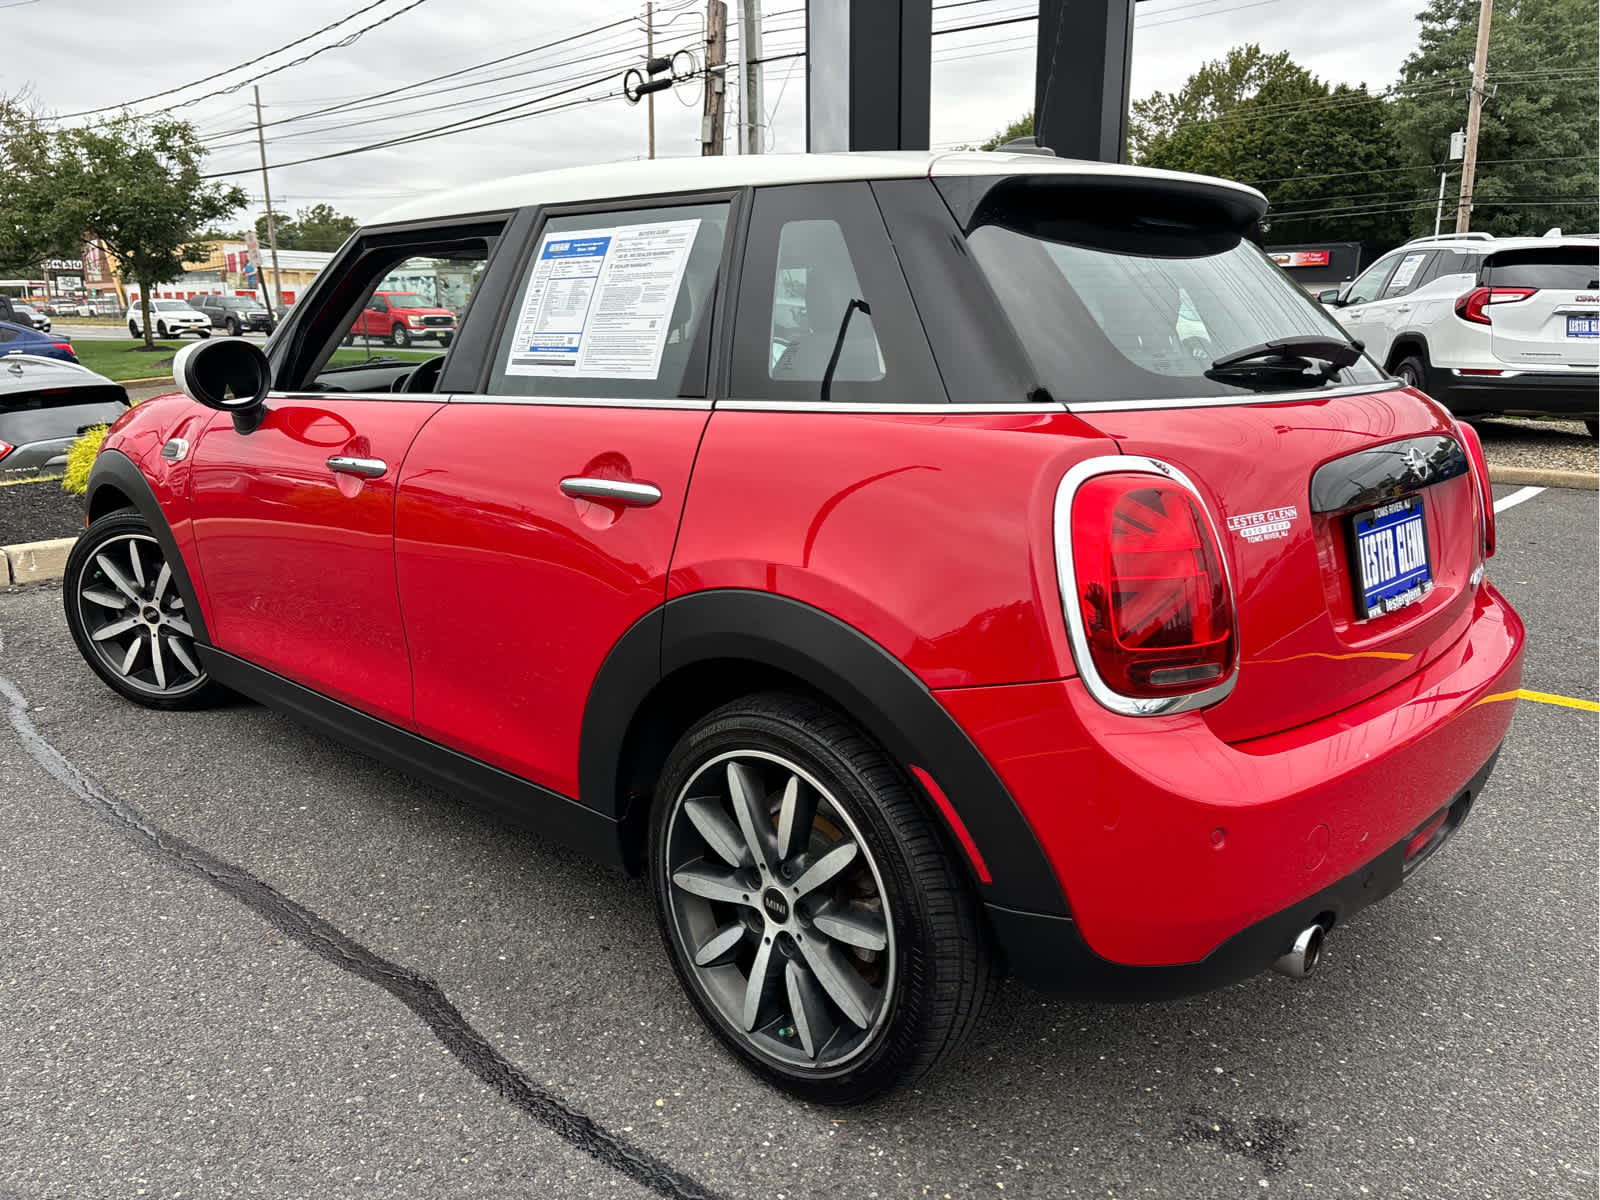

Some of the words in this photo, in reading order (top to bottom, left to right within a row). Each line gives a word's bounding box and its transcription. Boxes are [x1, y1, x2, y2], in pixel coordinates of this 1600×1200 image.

[1568, 320, 1588, 332] LESTER
[1227, 513, 1265, 529] LESTER
[1267, 507, 1297, 520] GLENN
[1360, 528, 1397, 590] LESTER
[1396, 518, 1426, 575] GLENN
[765, 897, 786, 915] MINI
